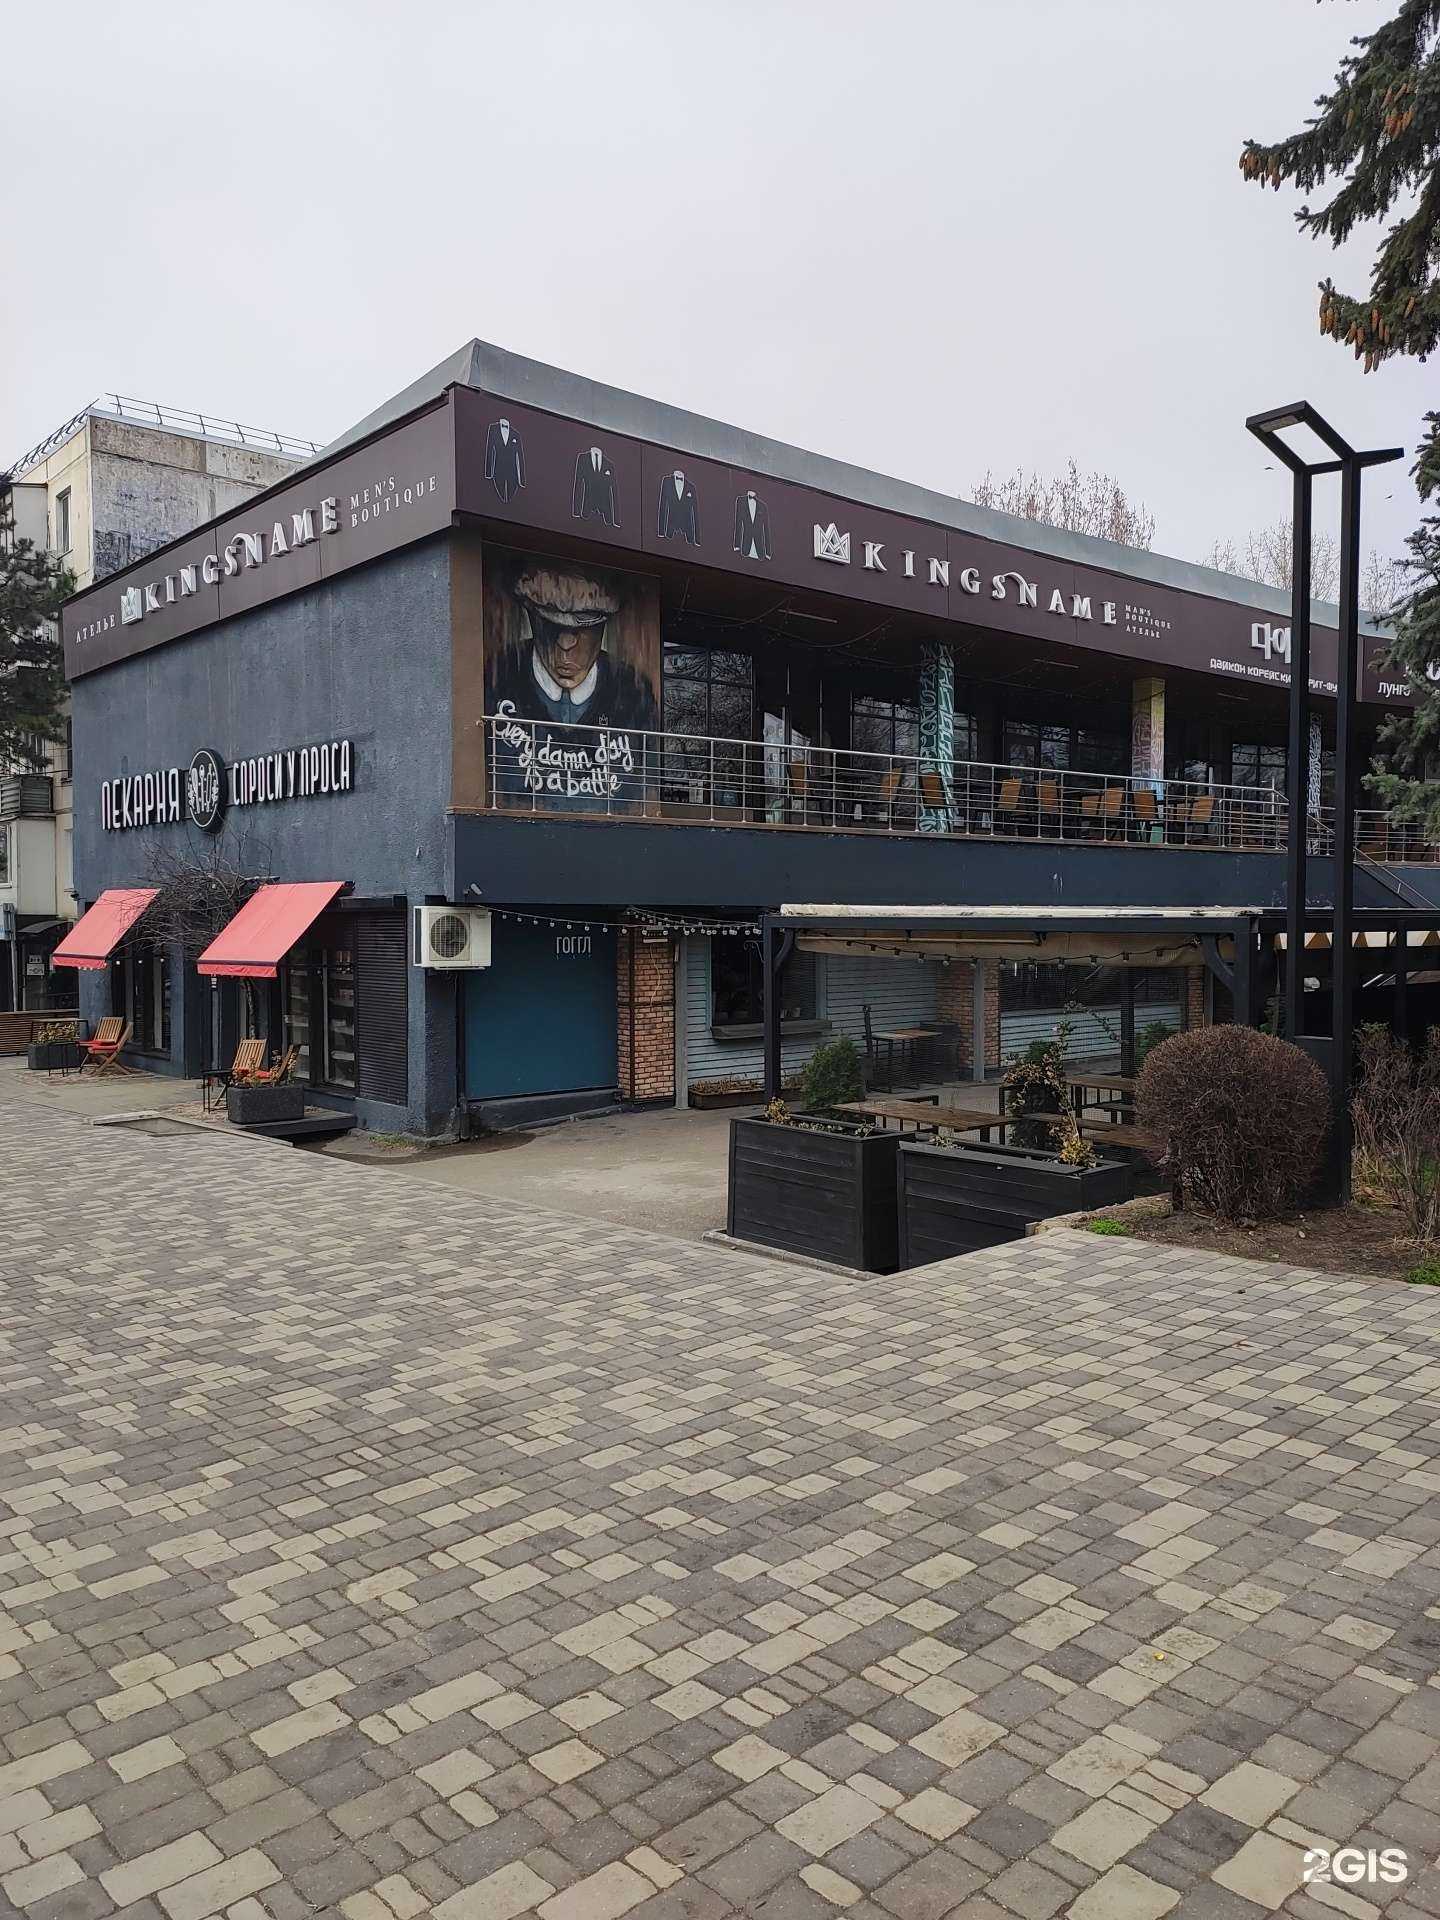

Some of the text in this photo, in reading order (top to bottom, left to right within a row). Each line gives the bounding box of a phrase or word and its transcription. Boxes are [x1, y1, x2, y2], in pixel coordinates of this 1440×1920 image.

[350, 476, 395, 510] MEN'S
[351, 476, 436, 528] BOUTIQUE
[144, 496, 338, 613] KINGSNAME
[862, 541, 1118, 626] KINGSNAME
[1125, 604, 1151, 617] MAN'S
[1125, 612, 1172, 630] BOUTIQUE
[76, 614, 116, 644] АТЕЛЬЕ
[1126, 624, 1161, 639] АТЕЛЬЕ
[1247, 665, 1291, 684] КОРЕЙСКИ
[1308, 678, 1338, 693] РИТ-ФУ
[538, 733, 593, 770] damn
[595, 733, 635, 772] day
[101, 739, 351, 831] ПЕКАРНЯ СПРОСИ У ПРОСА
[547, 771, 565, 793] a
[567, 766, 623, 797] battle
[556, 936, 591, 954] ГОГГЛ
